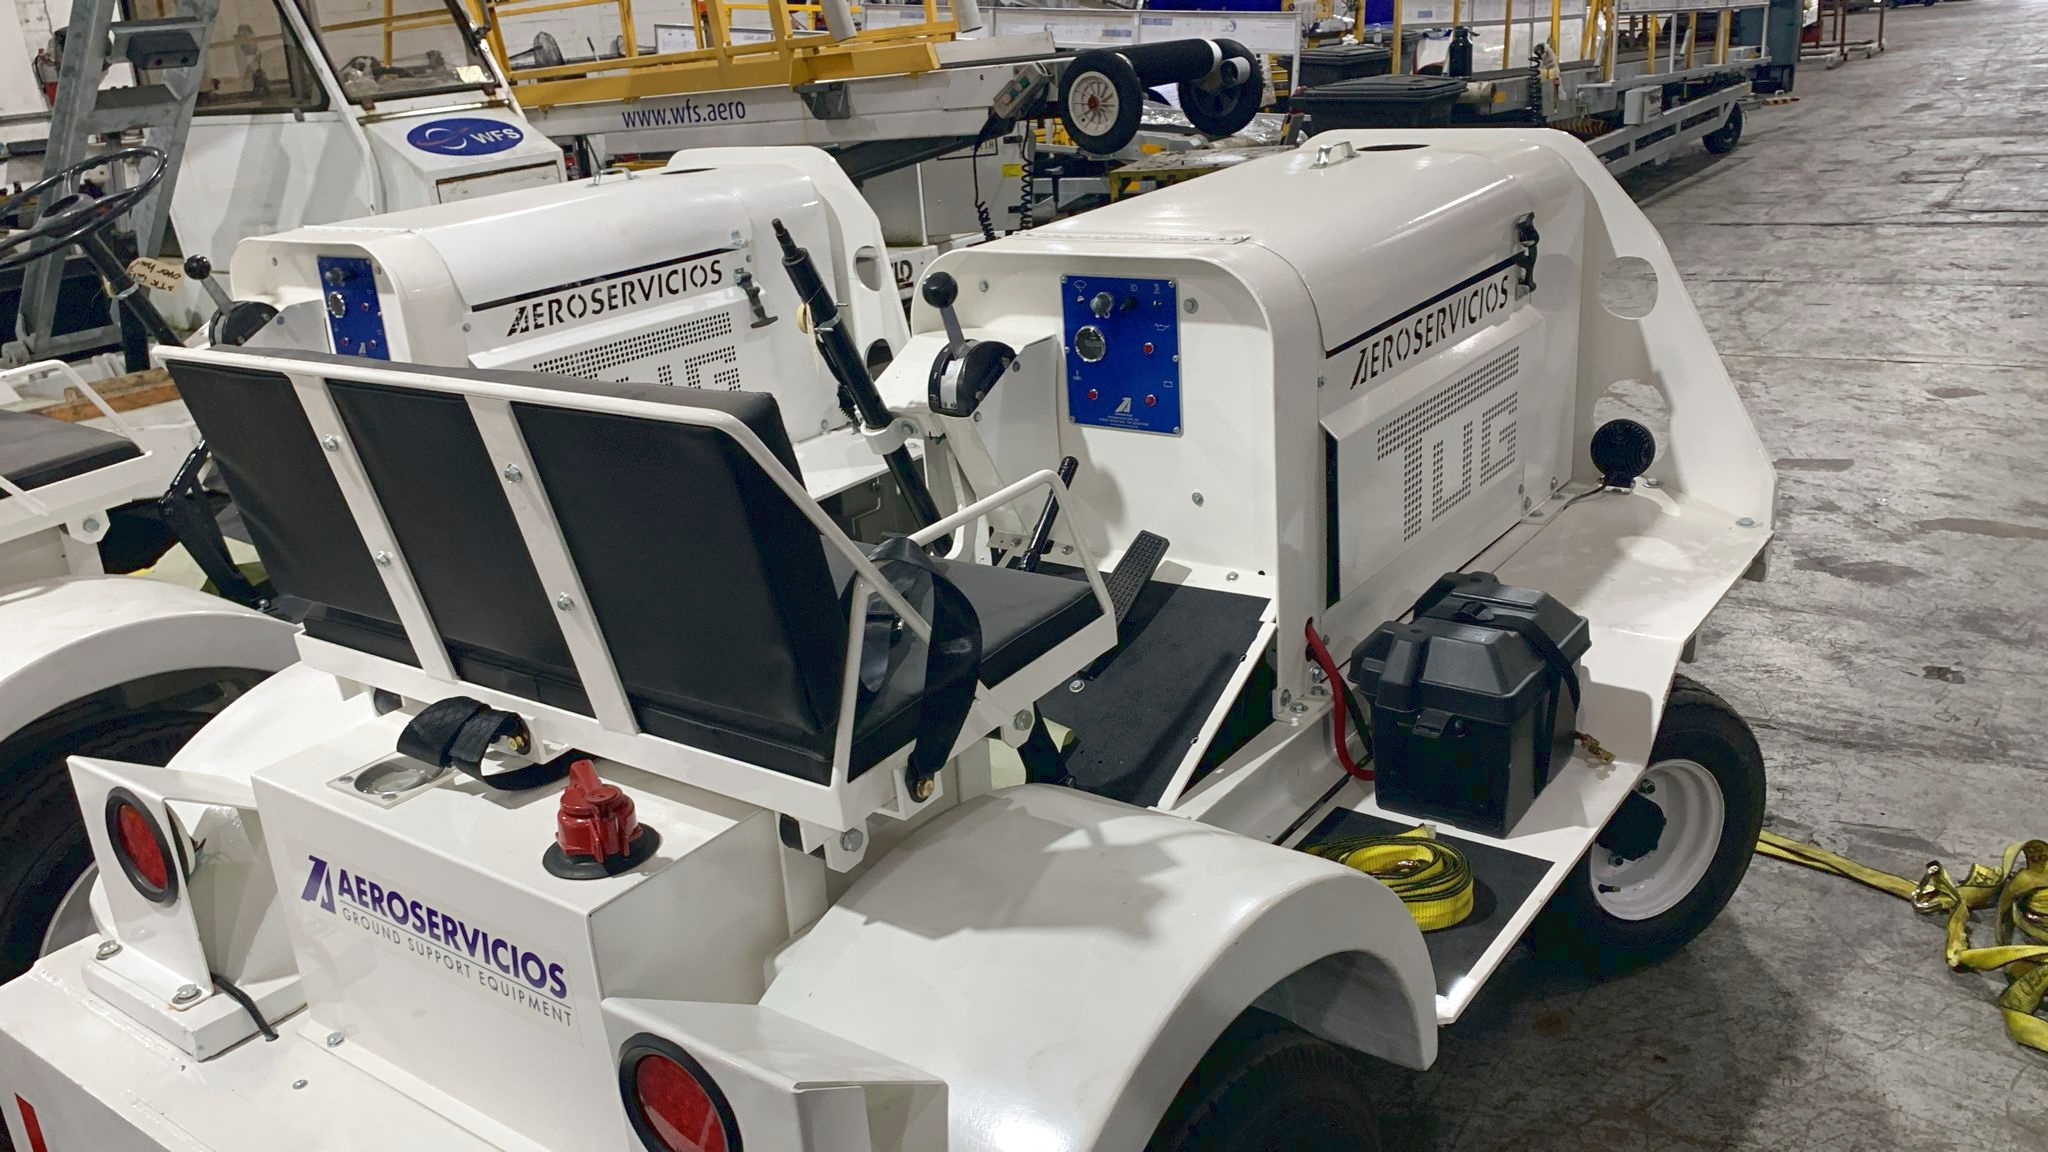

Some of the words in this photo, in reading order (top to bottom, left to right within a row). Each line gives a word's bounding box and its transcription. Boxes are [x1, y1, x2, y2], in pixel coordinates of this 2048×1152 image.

[470, 128, 520, 144] WFS
[622, 99, 746, 128] www.wfs.aero
[507, 259, 722, 337] AEROSERVICIOS
[1350, 275, 1508, 390] AEROSERVICIOS
[1377, 345, 1519, 542] TUG
[338, 868, 567, 1000] AEROSERVICIOS
[342, 907, 401, 945] GROUND
[408, 937, 471, 979] SUPPORT
[479, 971, 571, 1027] EQUIPMENT
